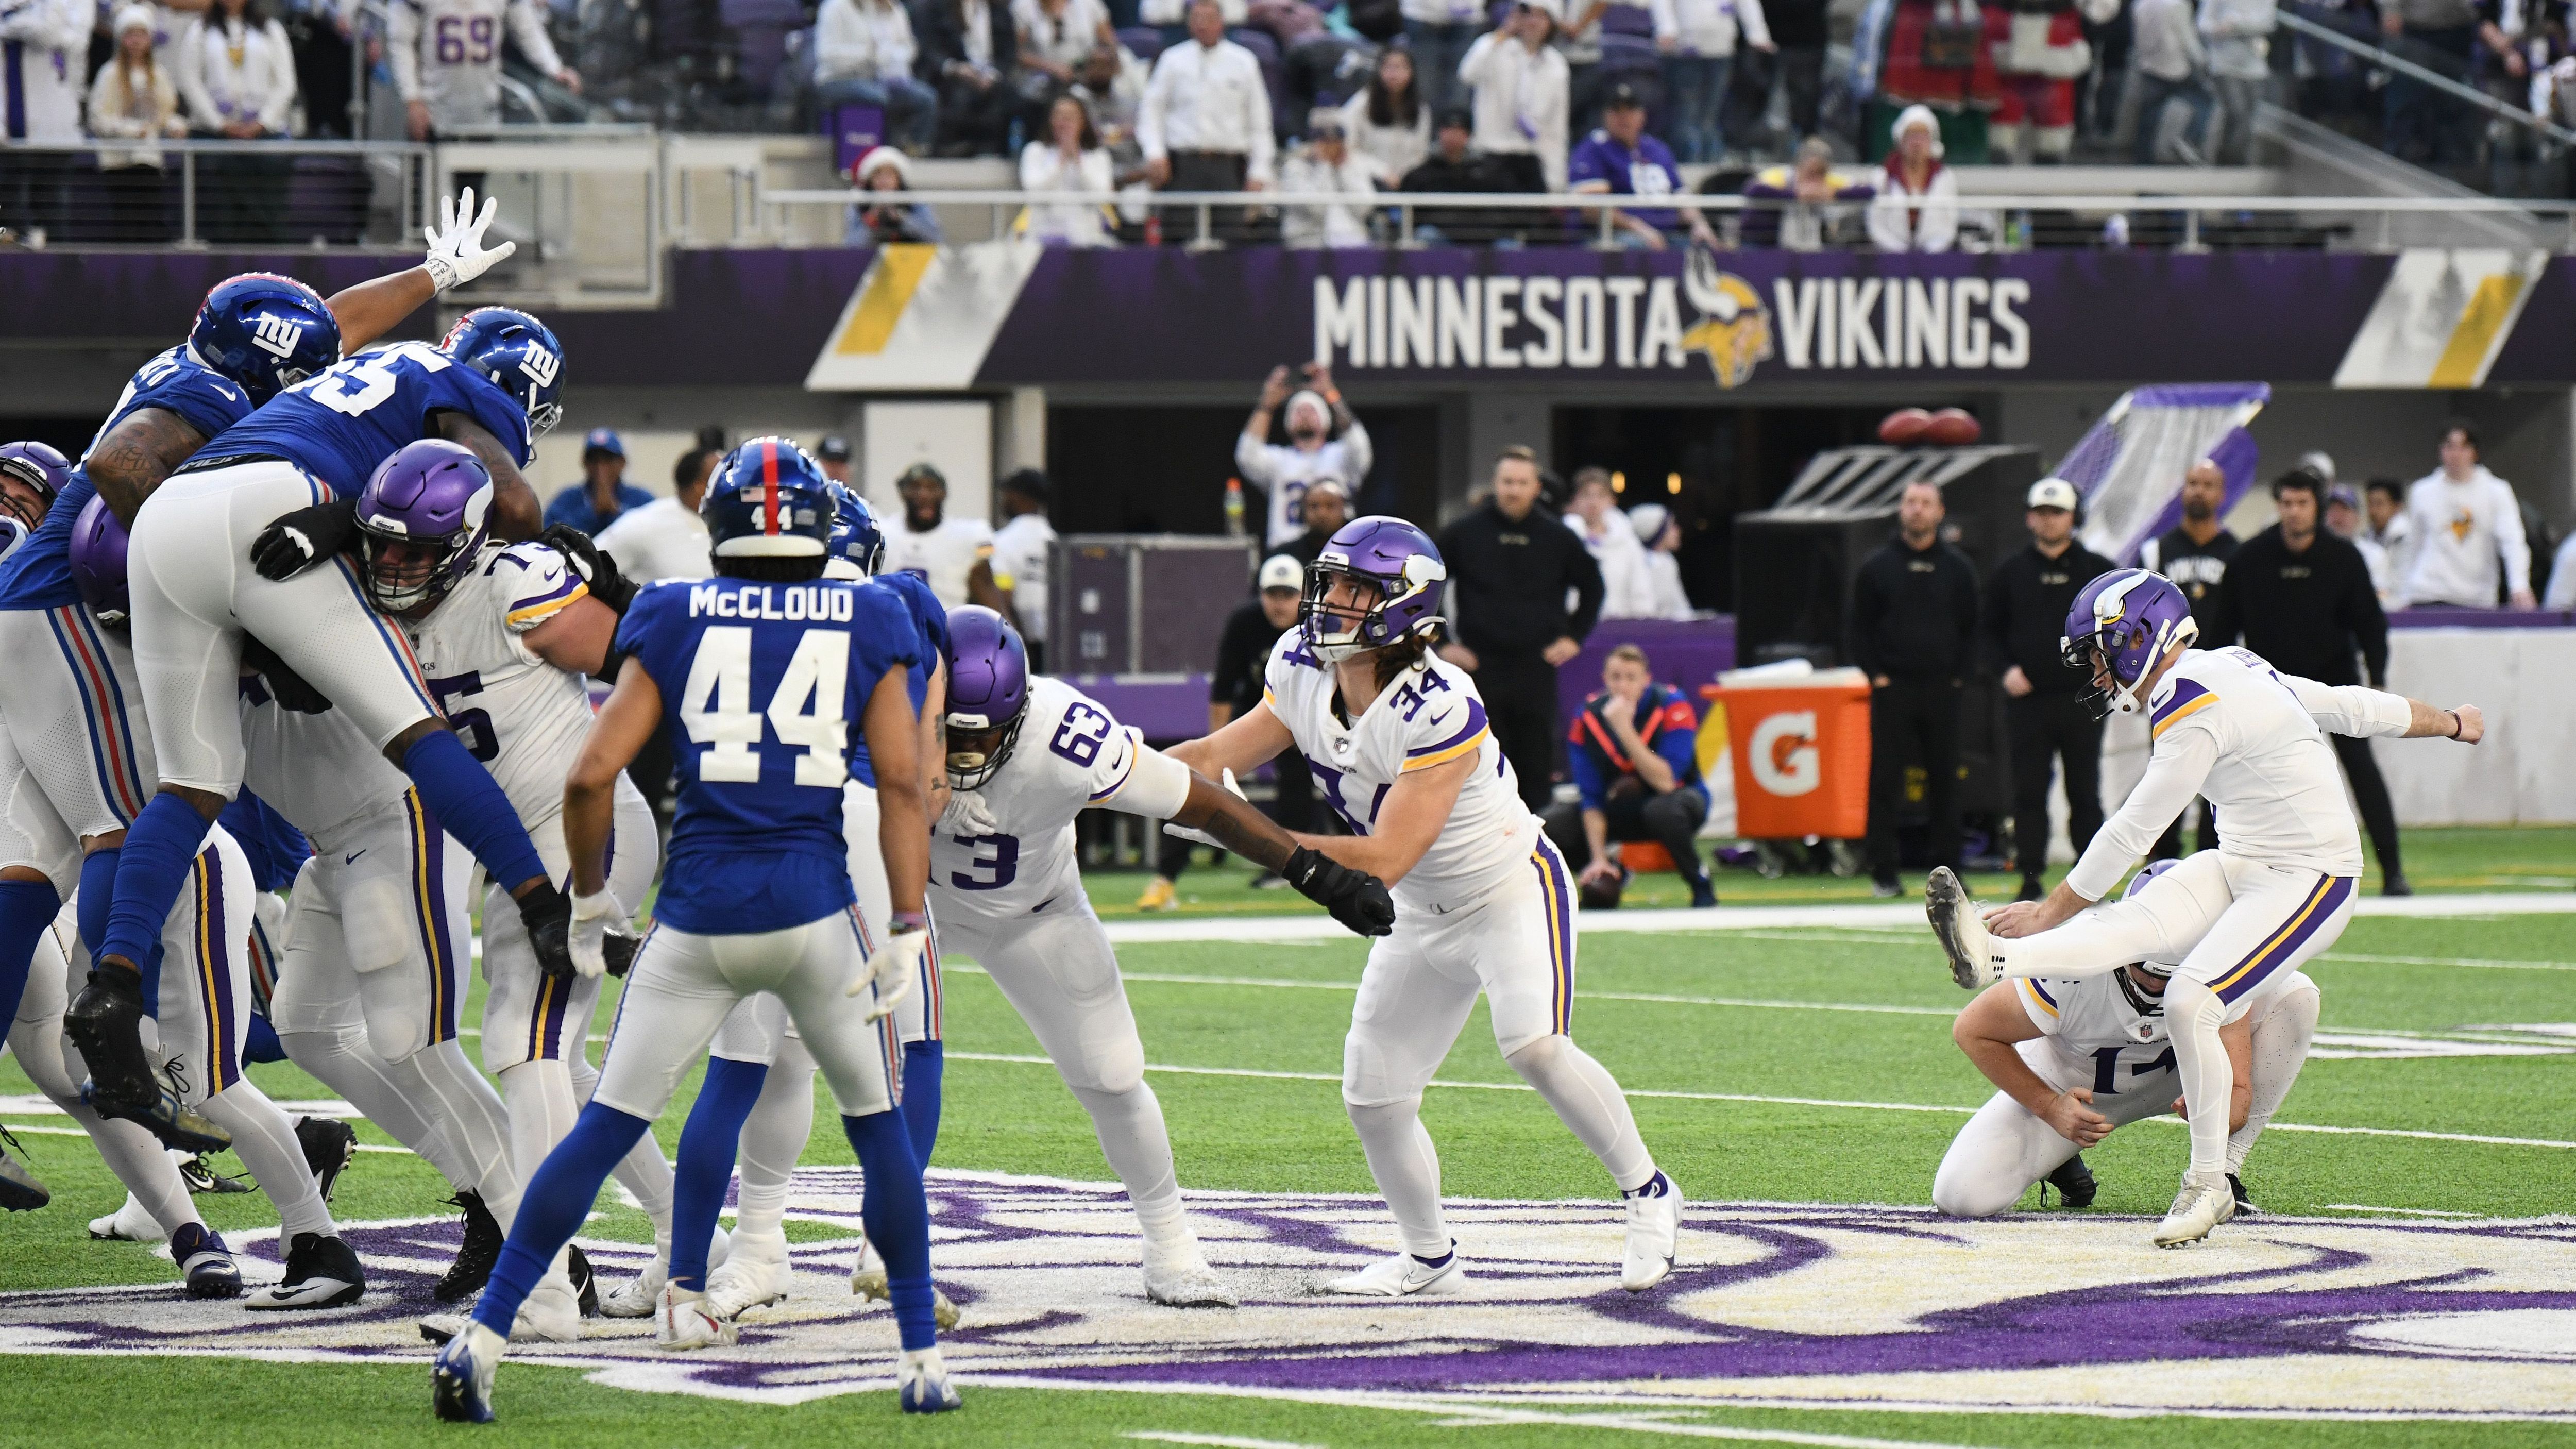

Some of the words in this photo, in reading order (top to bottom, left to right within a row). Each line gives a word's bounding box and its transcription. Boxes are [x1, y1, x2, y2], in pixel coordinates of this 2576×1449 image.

[437, 16, 493, 63] 69
[1313, 276, 1687, 368] MINNESOTA
[1773, 278, 2031, 369] VIKINGS
[751, 504, 792, 531] 44
[689, 585, 853, 622] McCLOUD
[680, 625, 851, 788] 44
[1389, 667, 1451, 722] 34
[1049, 701, 1111, 768] 63
[1748, 710, 1820, 797] G
